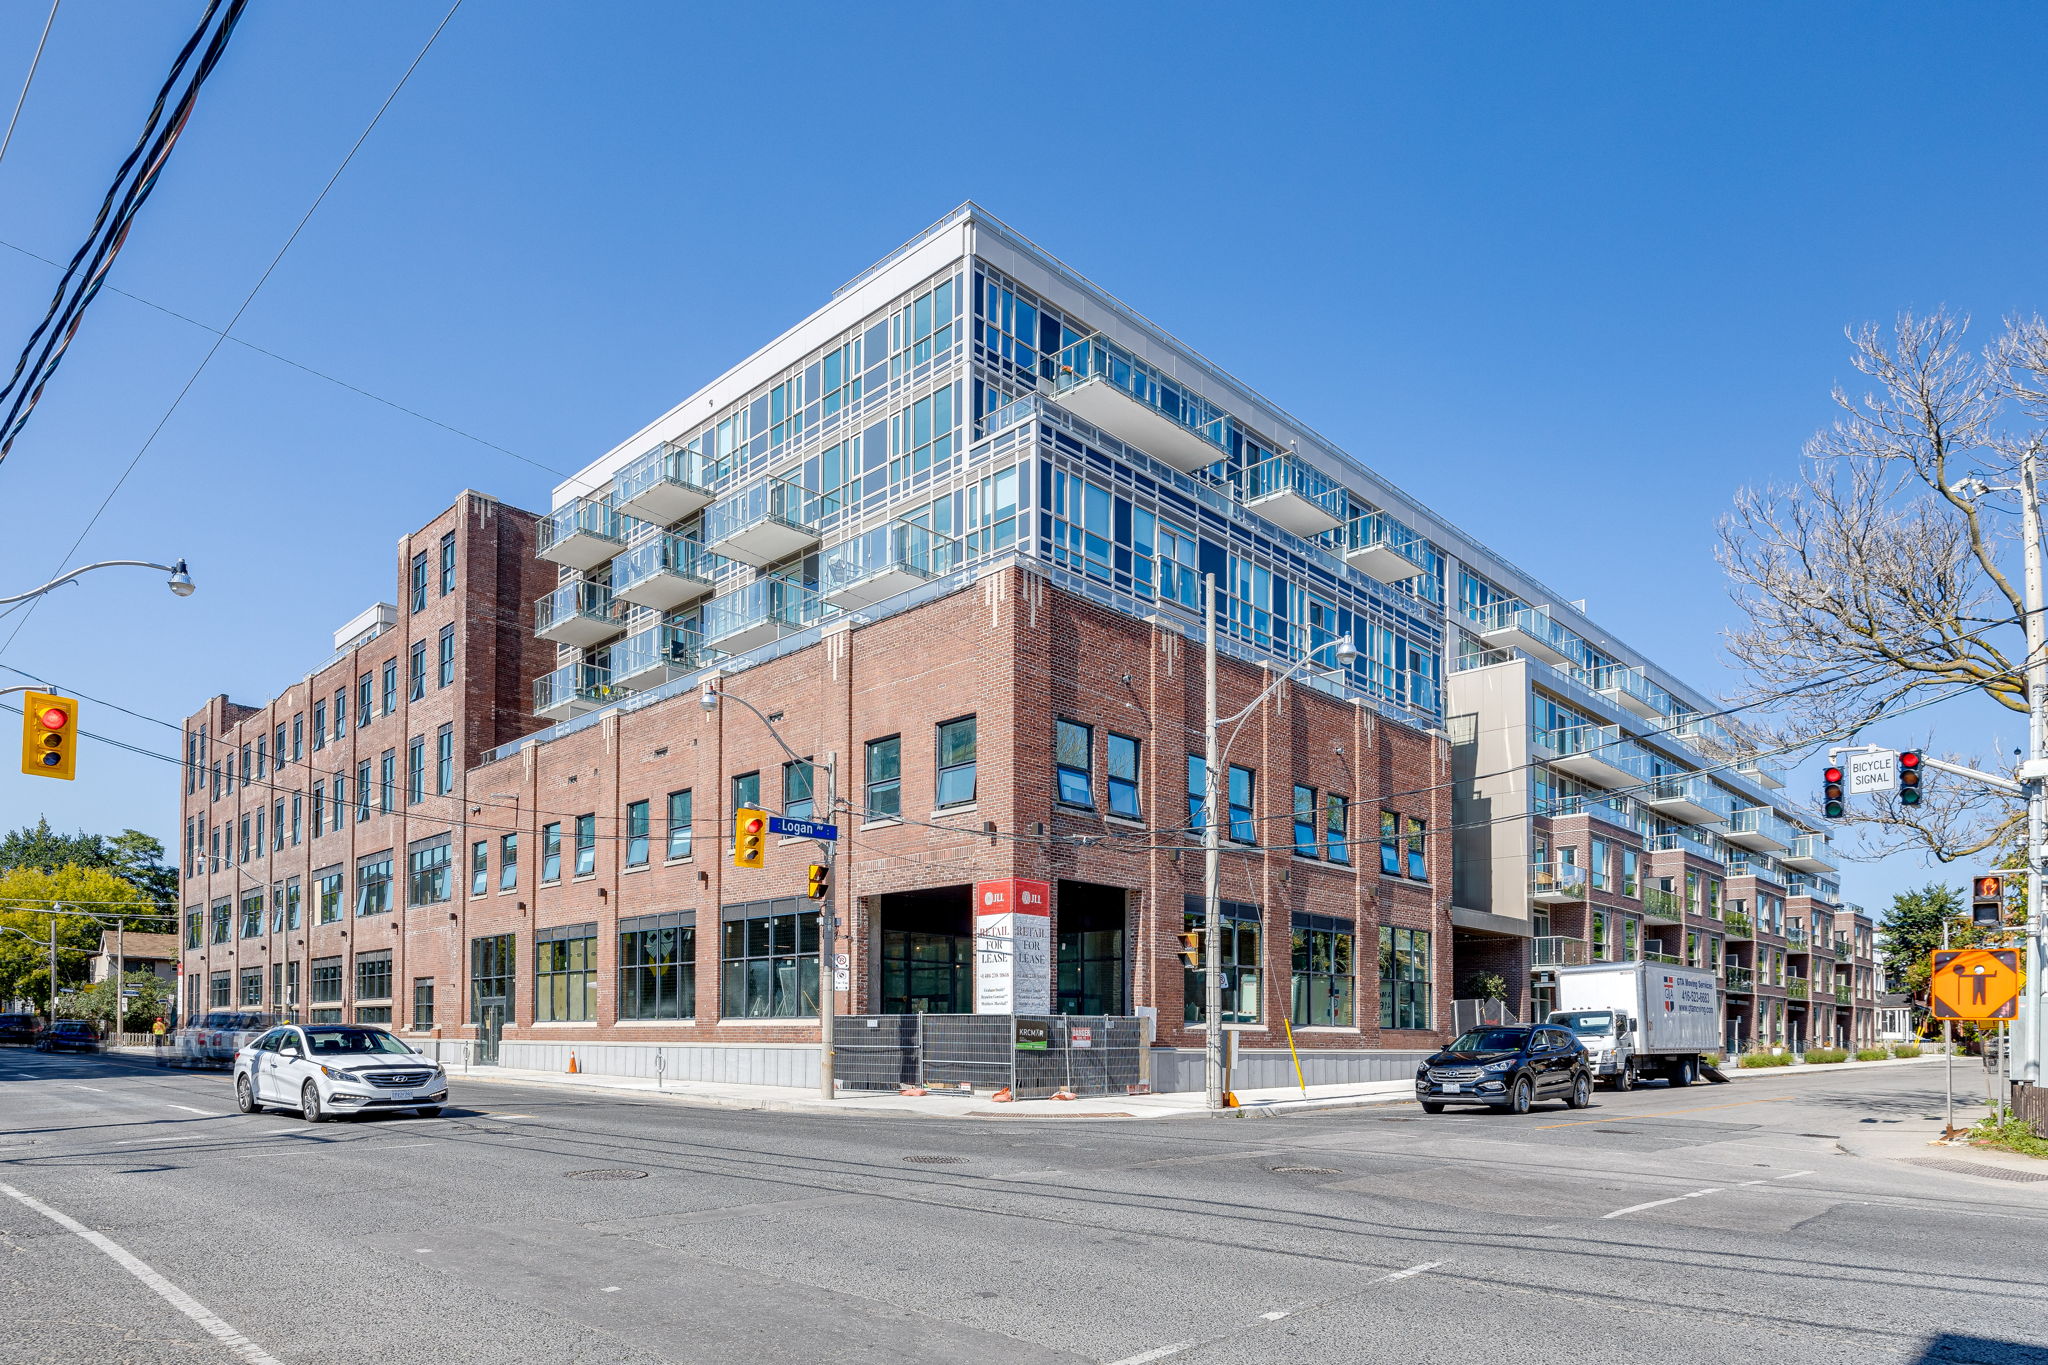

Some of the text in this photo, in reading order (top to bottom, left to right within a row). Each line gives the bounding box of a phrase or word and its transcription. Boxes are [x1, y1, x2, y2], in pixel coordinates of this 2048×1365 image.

[1853, 759, 1891, 772] BICYCLE
[1856, 773, 1889, 785] SIGNAL
[782, 819, 813, 835] Logan
[993, 893, 1004, 902] JLL
[1031, 894, 1042, 904] JLL
[980, 926, 1010, 936] RETAIL
[1016, 926, 1047, 938] RETAIL
[986, 940, 1002, 950] FOR
[1024, 940, 1040, 950] FOR
[982, 953, 1008, 964] LEASE
[1019, 953, 1046, 964] LEASE
[1685, 979, 1698, 989] Moving
[1698, 980, 1713, 990] Services
